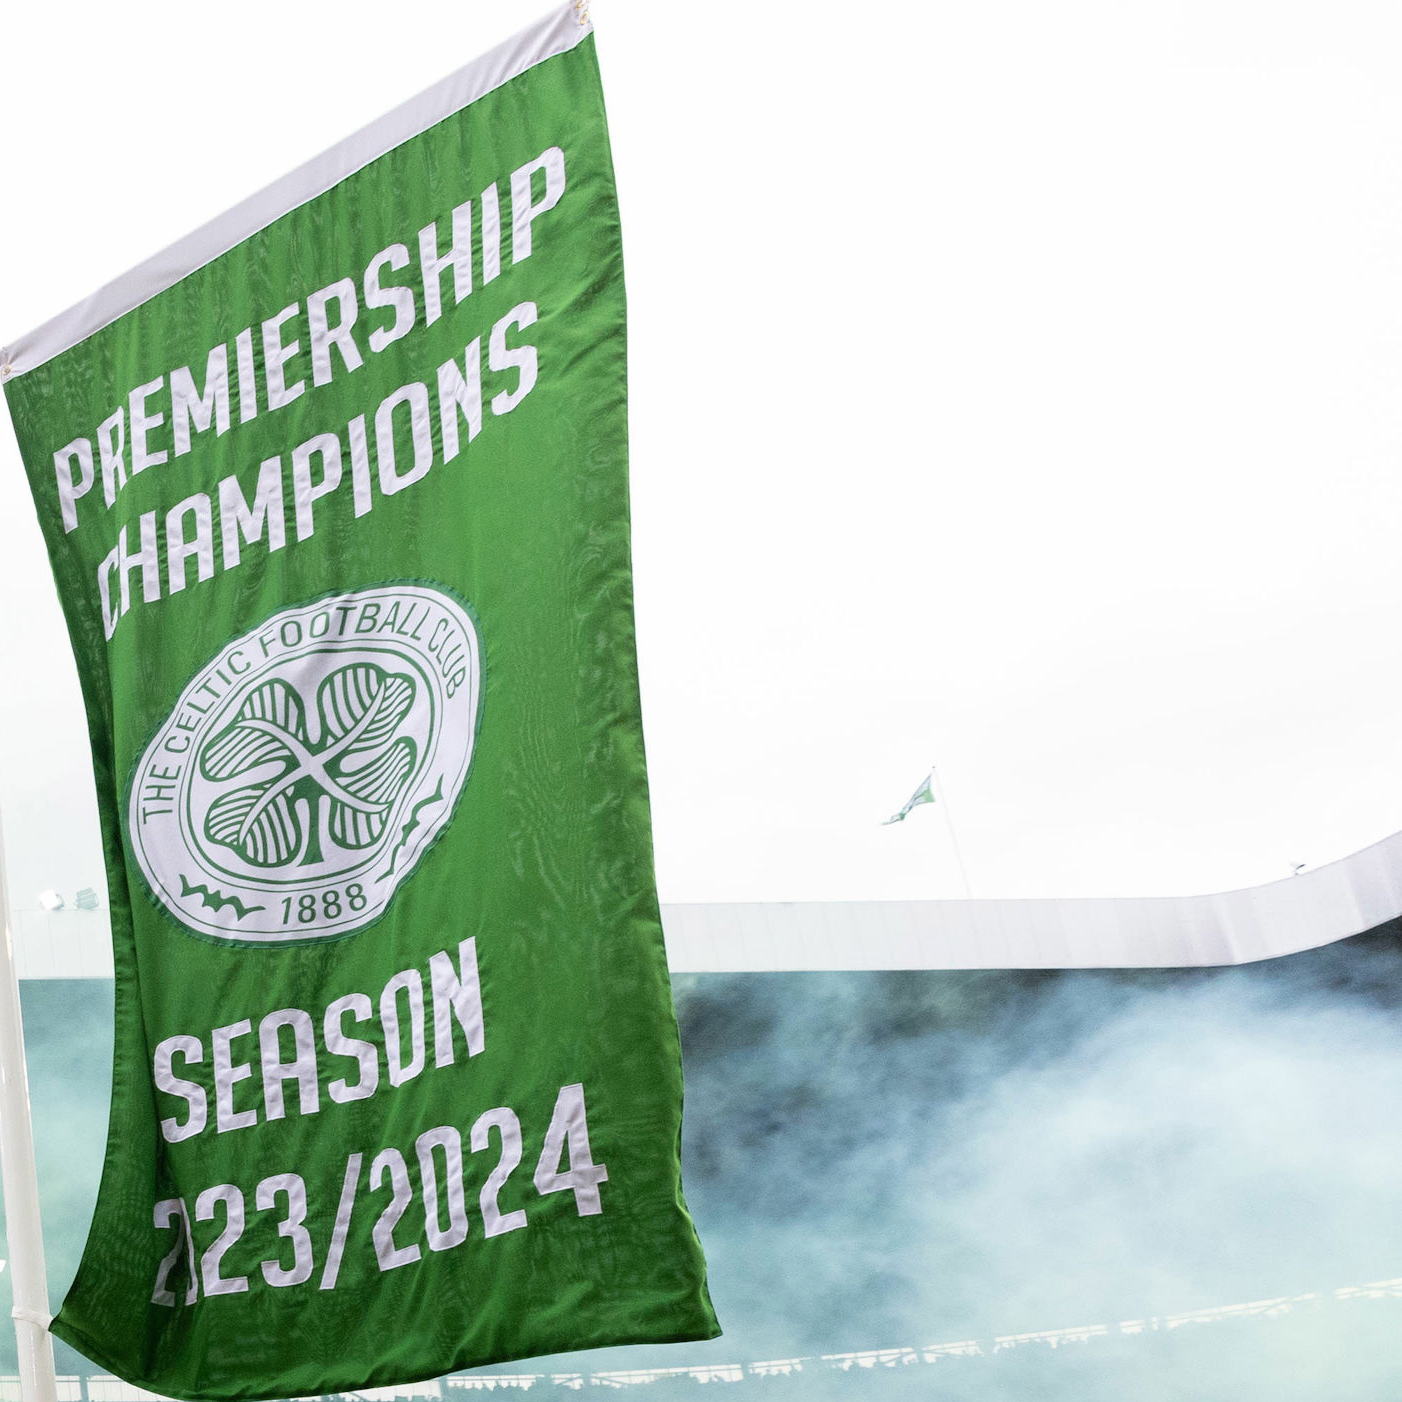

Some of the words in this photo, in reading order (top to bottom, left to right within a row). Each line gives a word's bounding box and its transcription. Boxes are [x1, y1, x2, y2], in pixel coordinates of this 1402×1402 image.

[53, 146, 566, 534] PREMIERSHIP
[98, 301, 537, 643] CHAMPIONS
[143, 763, 182, 825] THE
[165, 650, 252, 754] CELTIC
[258, 600, 432, 659] FOOTBALL
[427, 617, 468, 700] CLUB
[280, 882, 369, 926] 1888
[153, 936, 485, 1143] SEASON
